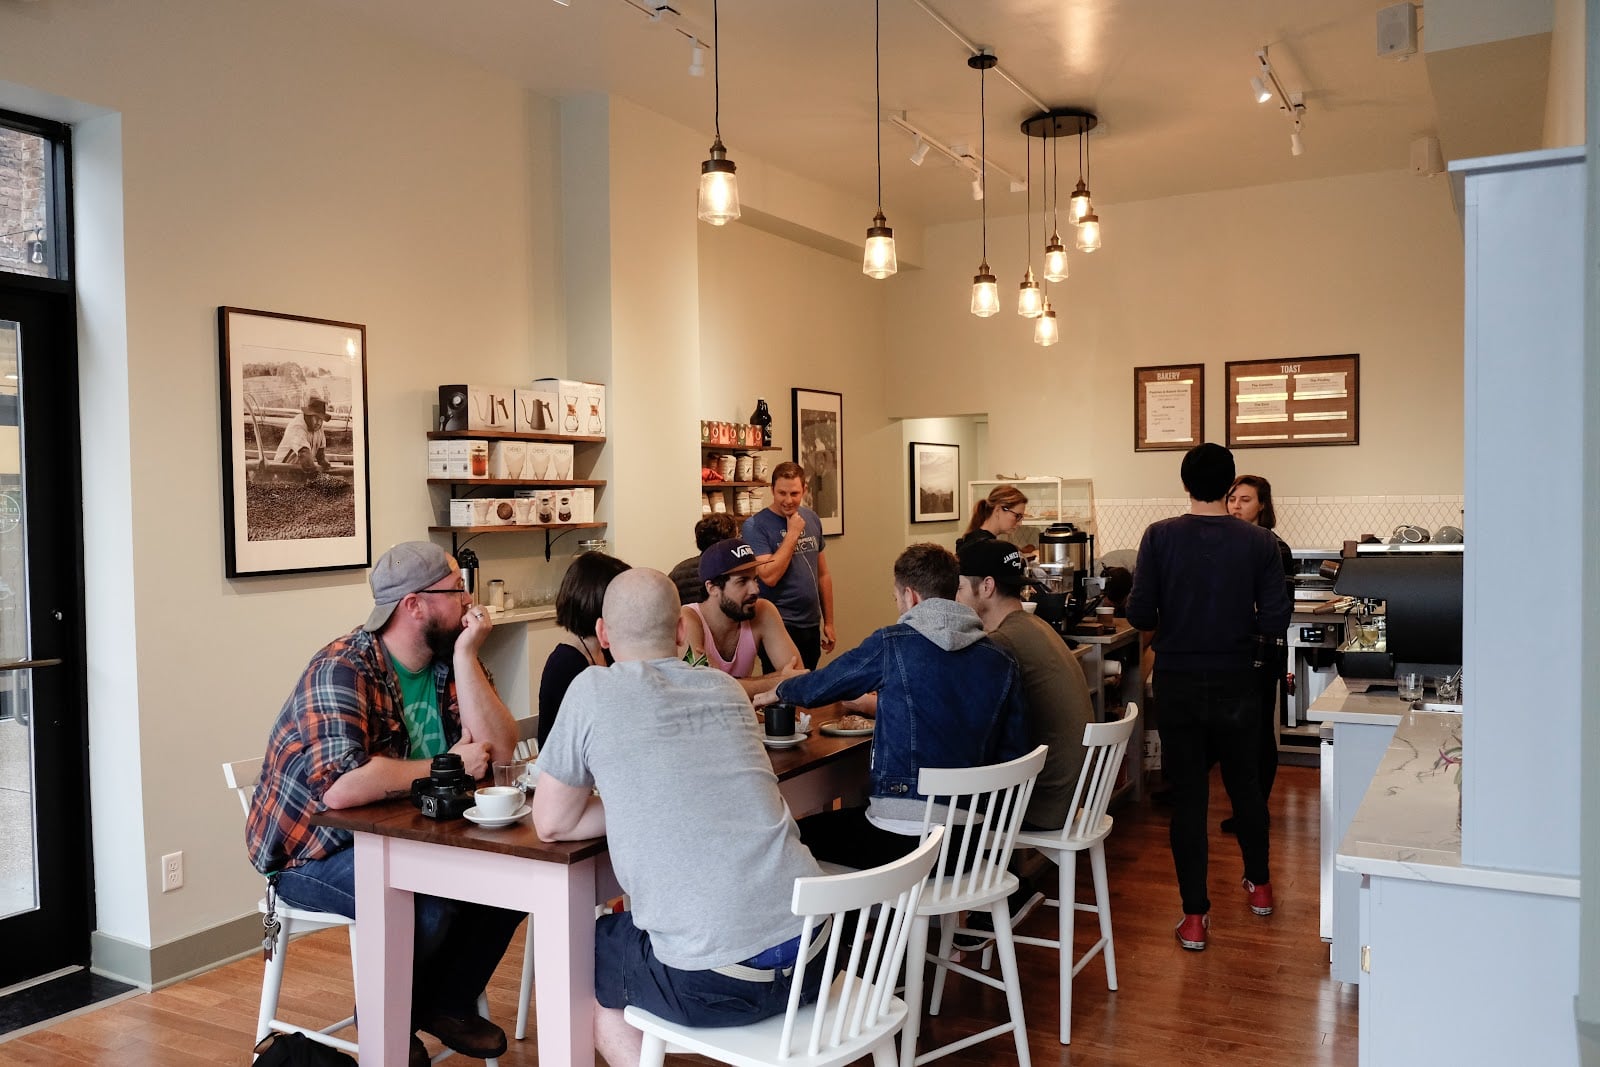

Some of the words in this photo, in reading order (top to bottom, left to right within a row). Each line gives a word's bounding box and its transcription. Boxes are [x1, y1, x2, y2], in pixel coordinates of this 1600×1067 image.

[1280, 364, 1301, 374] TOAST
[1157, 371, 1180, 380] BAKERY
[730, 544, 754, 558] VAN
